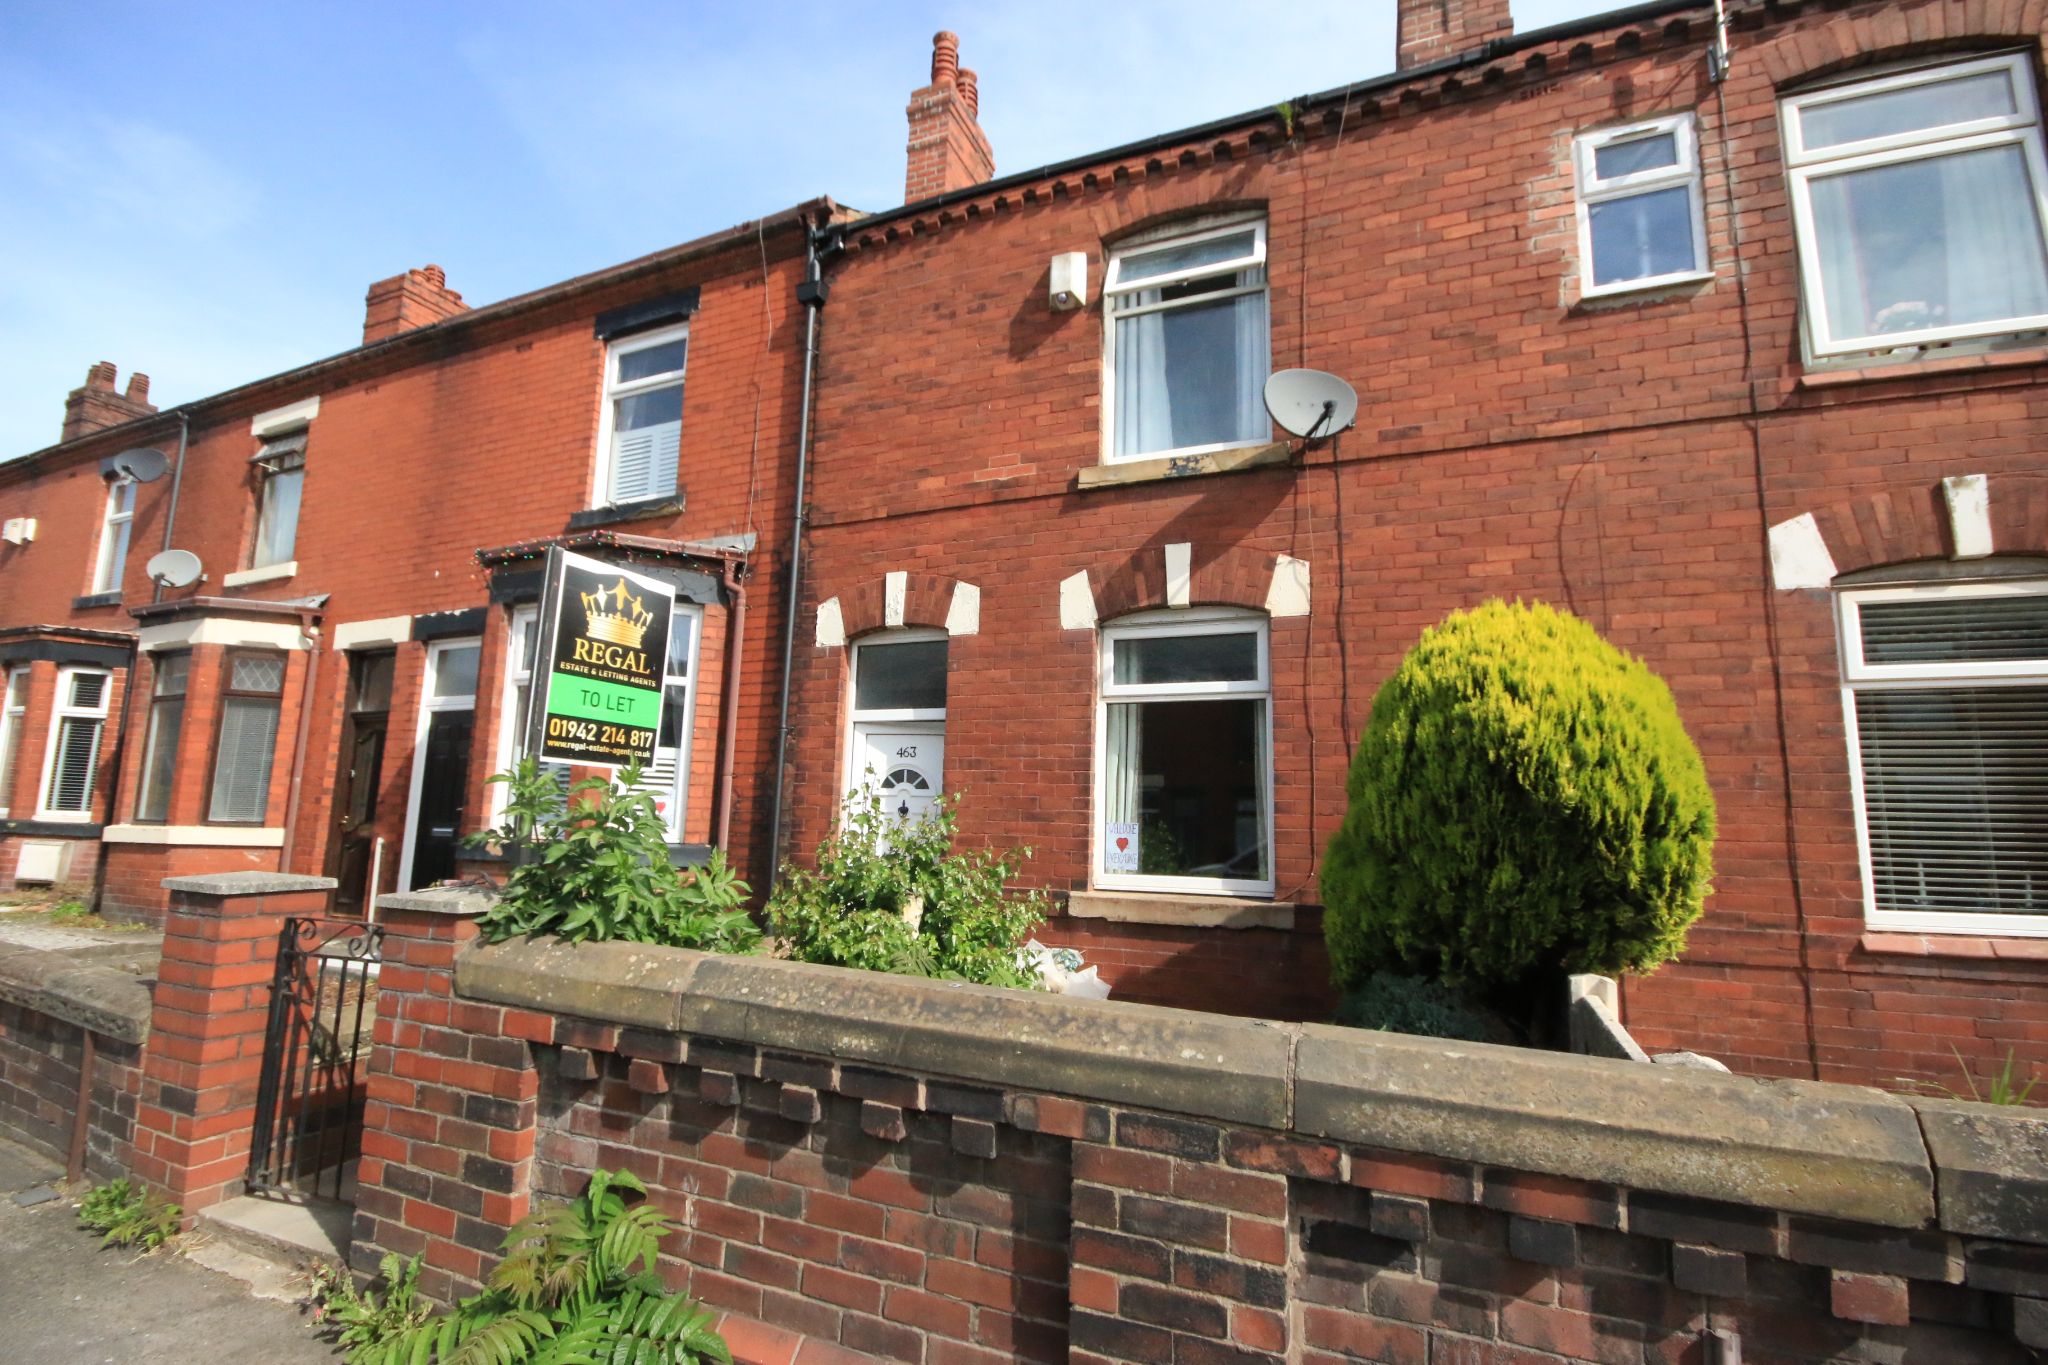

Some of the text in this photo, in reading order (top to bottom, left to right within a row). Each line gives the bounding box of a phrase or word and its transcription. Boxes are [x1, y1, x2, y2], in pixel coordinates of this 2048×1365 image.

[572, 637, 651, 675] REGAL
[560, 661, 589, 674] ESTATE
[598, 669, 629, 682] LETTING
[629, 676, 656, 687] AGENTS
[580, 689, 636, 713] TO LET
[549, 717, 654, 748] 01942 214 817
[896, 746, 917, 758] 463
